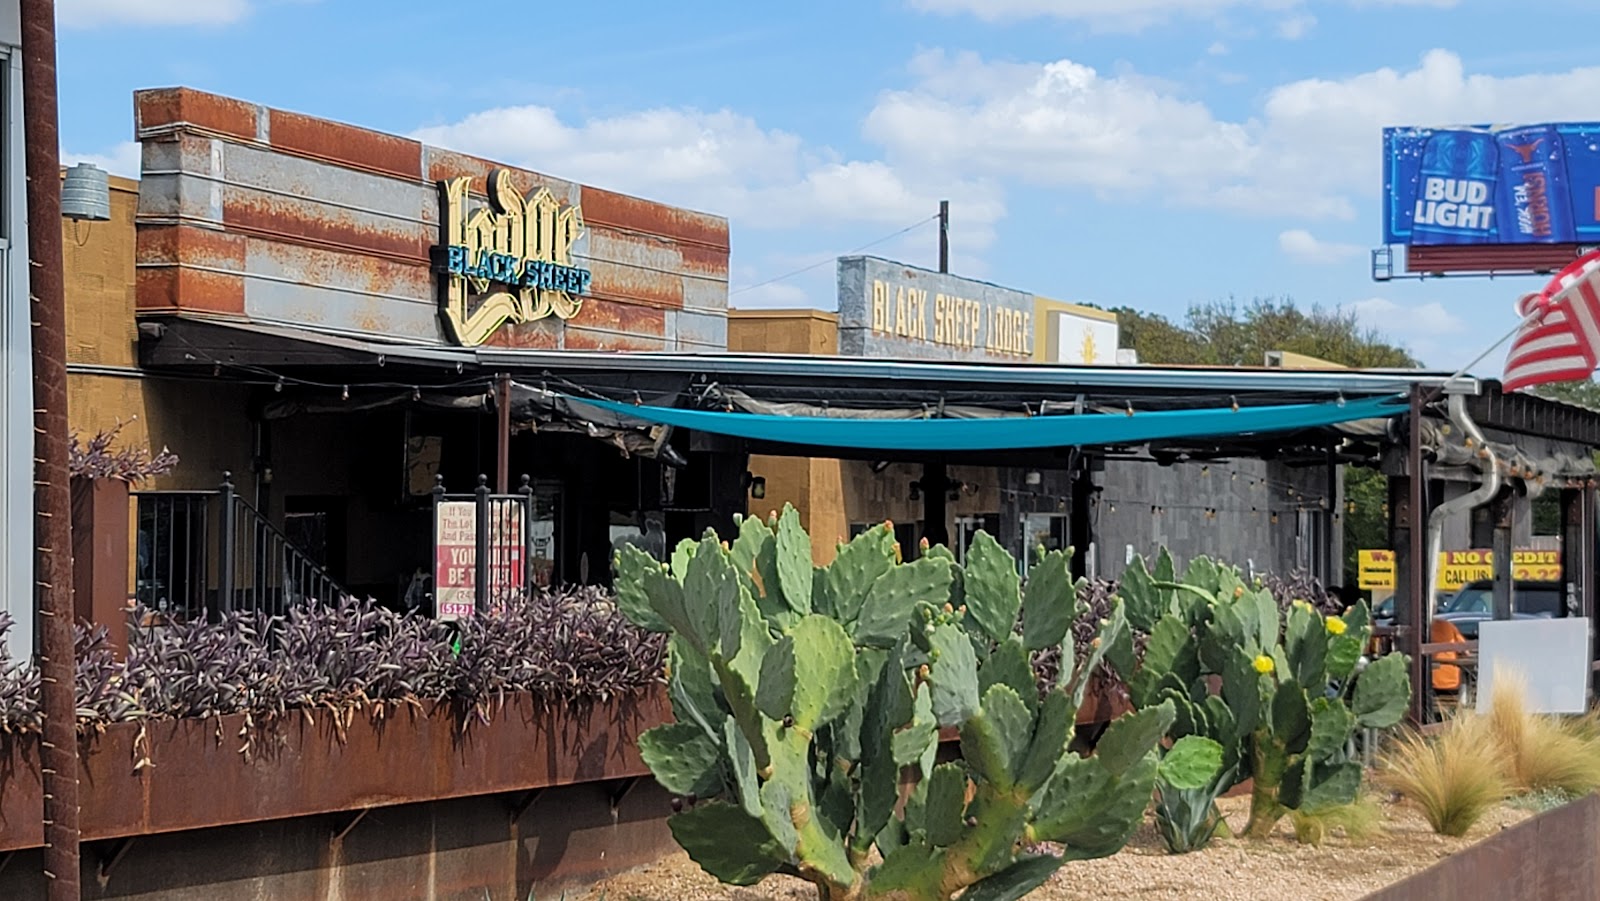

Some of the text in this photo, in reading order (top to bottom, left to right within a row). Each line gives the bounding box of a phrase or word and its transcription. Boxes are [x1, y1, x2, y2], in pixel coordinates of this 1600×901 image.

[1425, 177, 1488, 205] BUD
[1413, 200, 1494, 230] LIGHT
[448, 245, 592, 295] BLACK SHEEP
[873, 279, 1033, 357] BLACK SHEEP LODGE
[450, 547, 476, 566] YOU
[1453, 551, 1557, 564] NO CEDIT
[448, 567, 465, 585] BE
[1445, 569, 1468, 584] CALL
[441, 602, 470, 615] (512)
